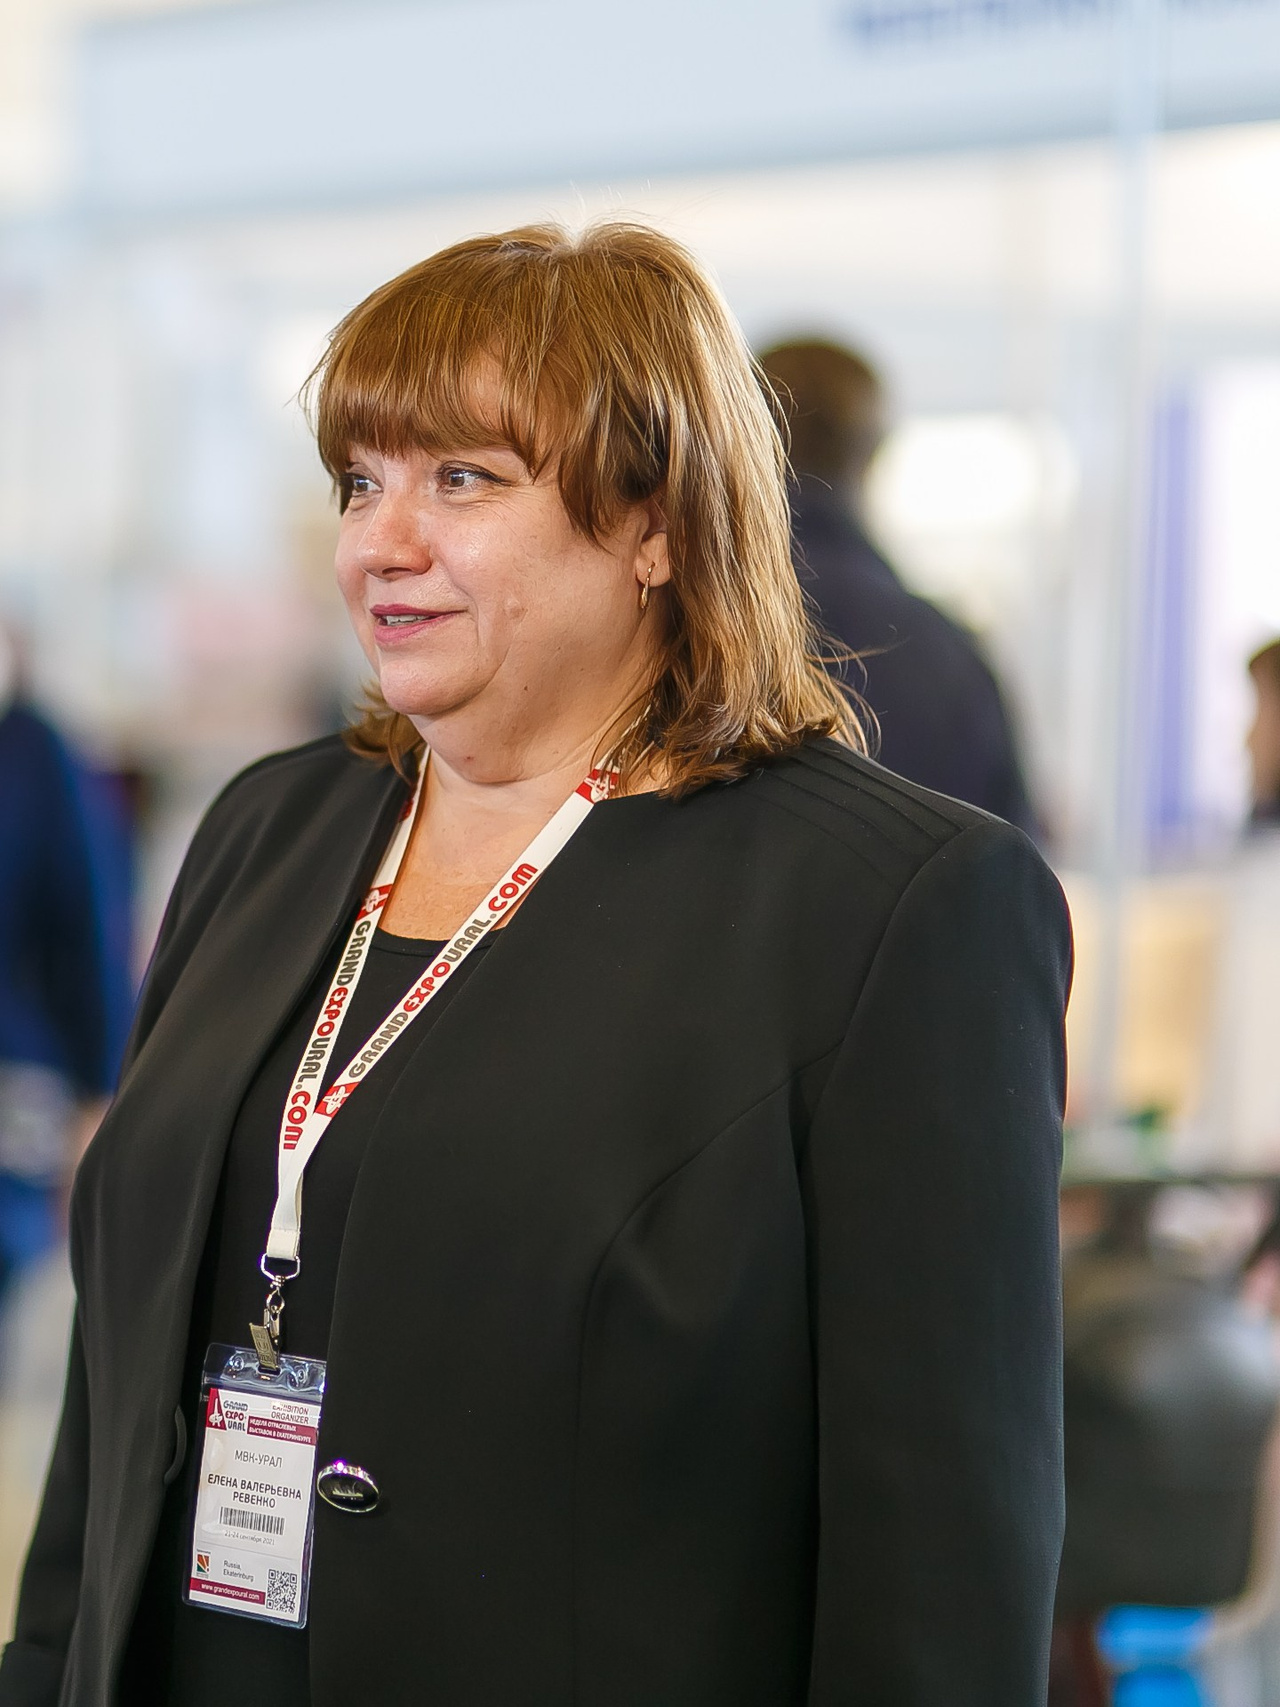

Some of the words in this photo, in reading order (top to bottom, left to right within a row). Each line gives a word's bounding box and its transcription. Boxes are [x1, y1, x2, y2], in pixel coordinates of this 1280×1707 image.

[348, 862, 539, 1080] GRANDEXPOURAL.COM
[282, 919, 372, 1151] GRANDEXPOURAL.COM
[223, 1400, 249, 1412] GRAND
[227, 1420, 246, 1432] URAL
[270, 1411, 310, 1425] ORGANIZER
[234, 1449, 283, 1468] МВК-УРАЛ
[207, 1473, 238, 1489] ЕЛЕНА
[240, 1479, 302, 1500] ВАЛЕРЬЕВНА
[232, 1491, 276, 1509] РЕВЕНКО
[223, 1569, 255, 1583] Ekaterinburg
[201, 1583, 260, 1600] www.grandexpoural.com
